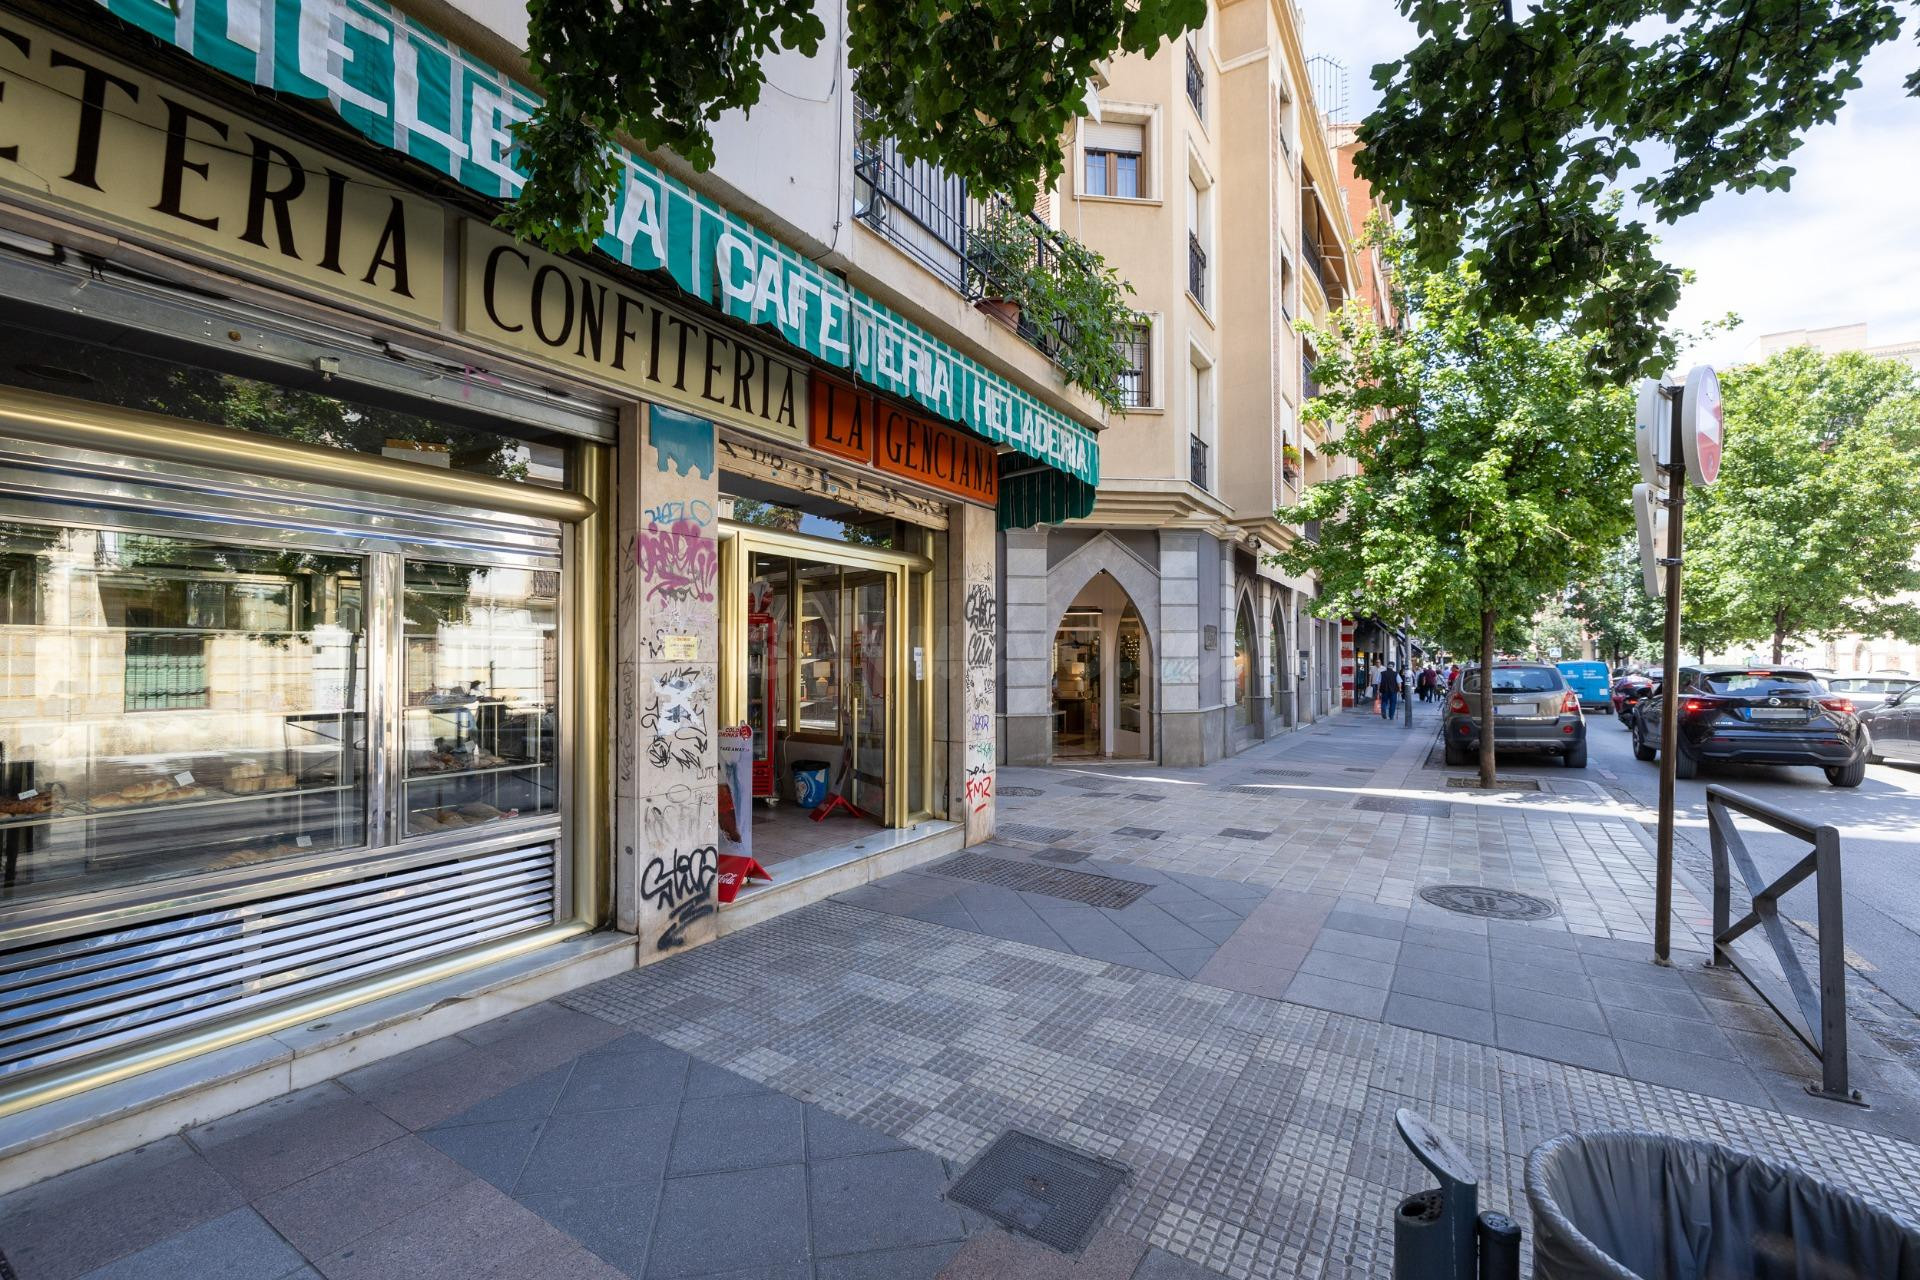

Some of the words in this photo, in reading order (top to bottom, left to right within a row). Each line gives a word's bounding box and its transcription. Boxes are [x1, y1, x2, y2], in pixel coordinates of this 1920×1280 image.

[483, 245, 798, 430] CONFITERIA
[717, 232, 951, 408] CAFETERIA
[973, 378, 1088, 473] HELADERIA
[825, 383, 864, 451] LA
[886, 411, 994, 496] GENCIANA
